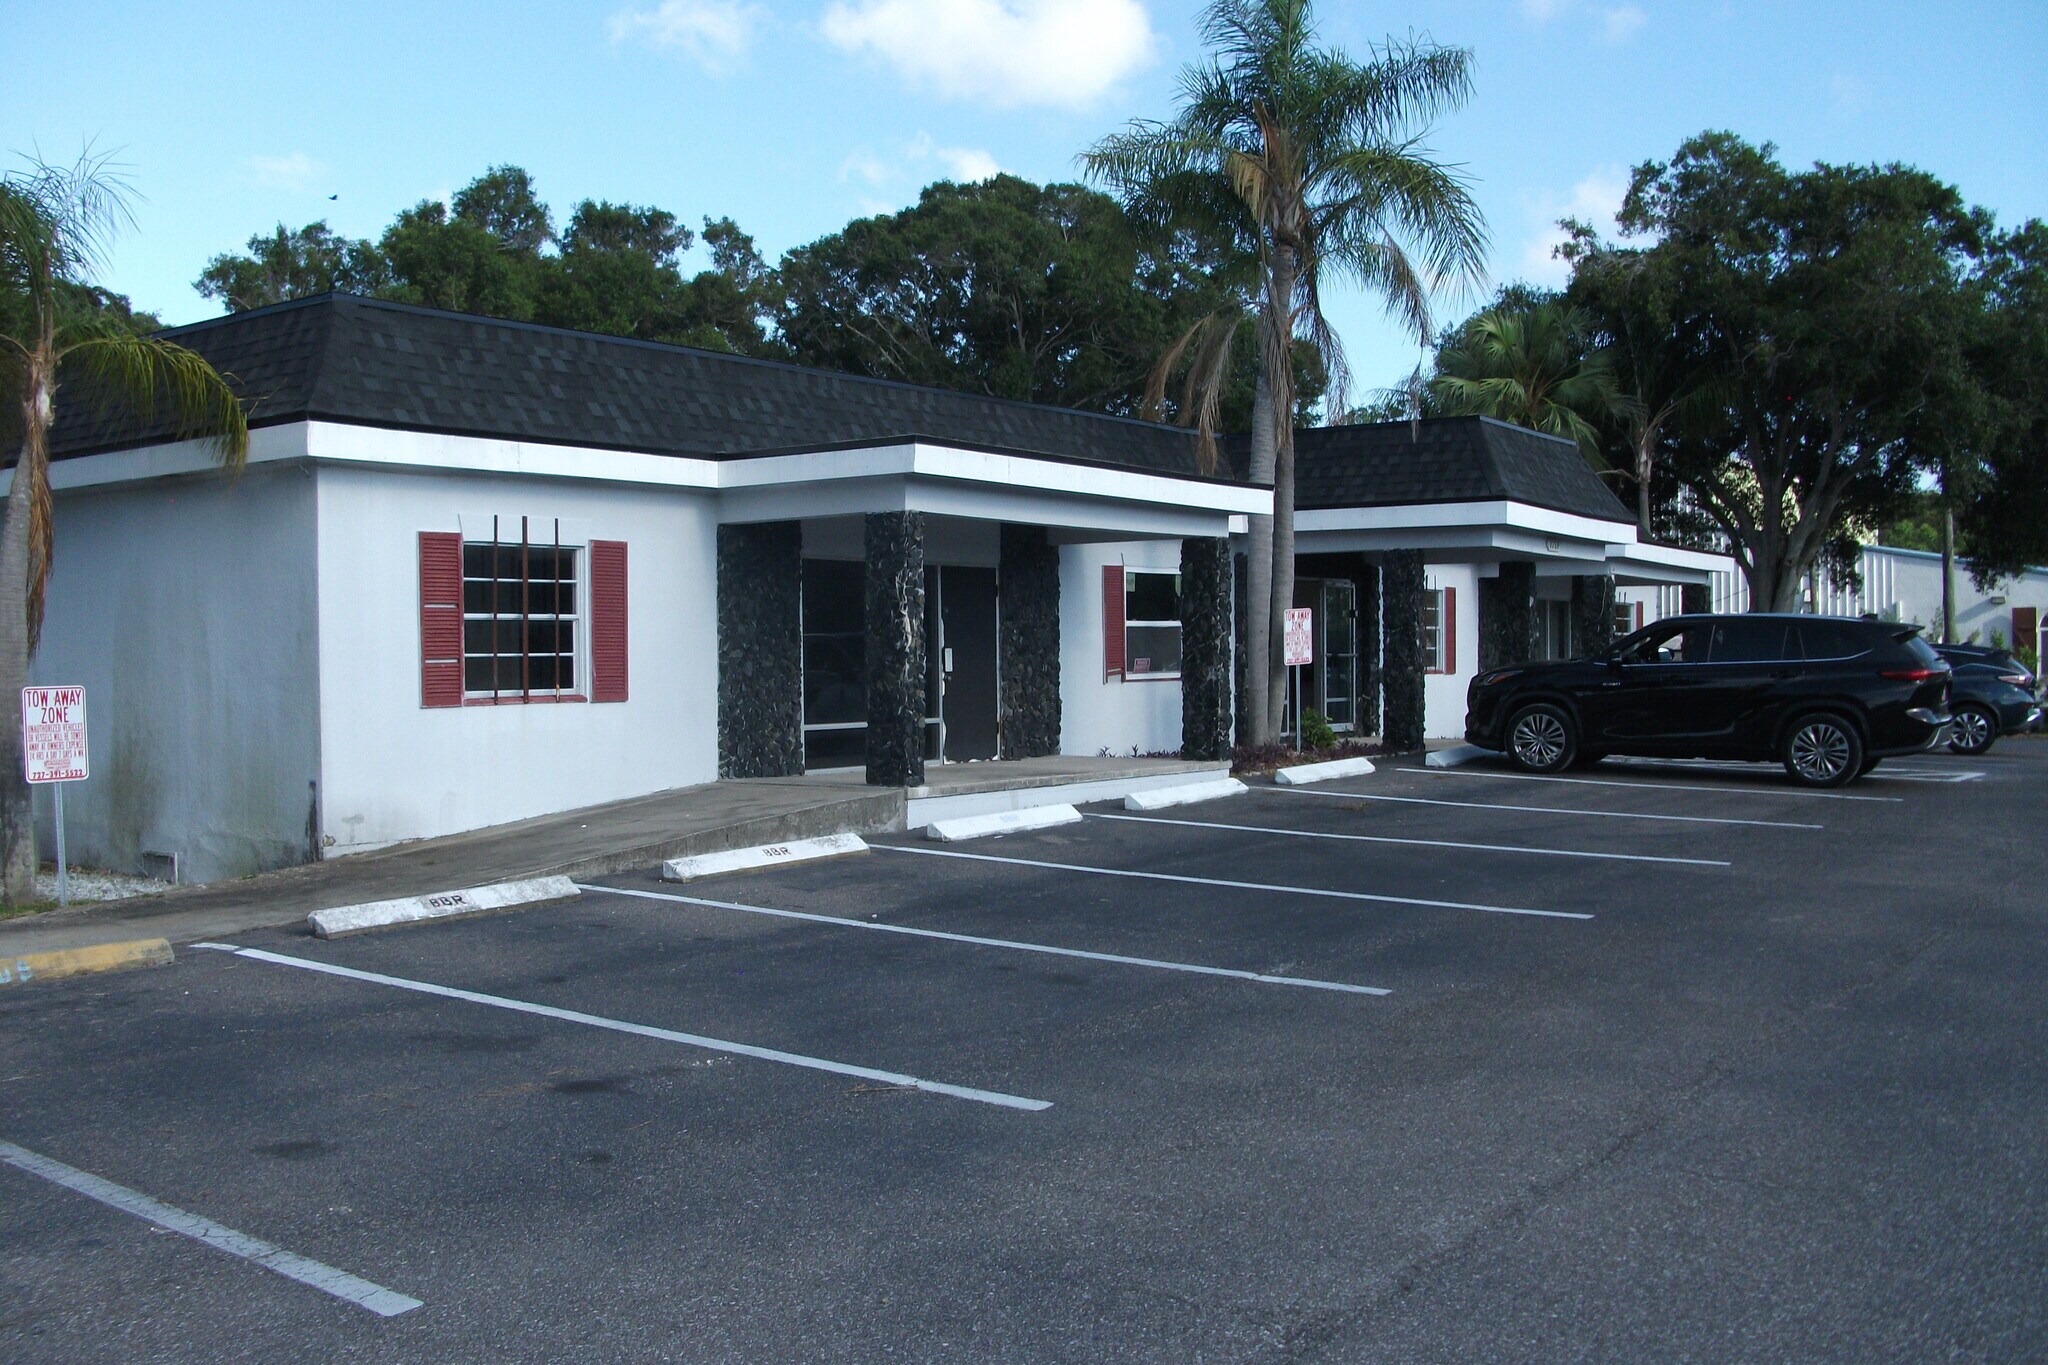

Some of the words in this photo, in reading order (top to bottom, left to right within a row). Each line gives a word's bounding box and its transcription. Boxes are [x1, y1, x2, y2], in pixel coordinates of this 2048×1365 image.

[27, 691, 48, 707] TOW
[54, 690, 81, 706] AWAY
[41, 706, 69, 724] ZONE
[761, 846, 791, 857] BBR
[428, 895, 467, 907] BBR
